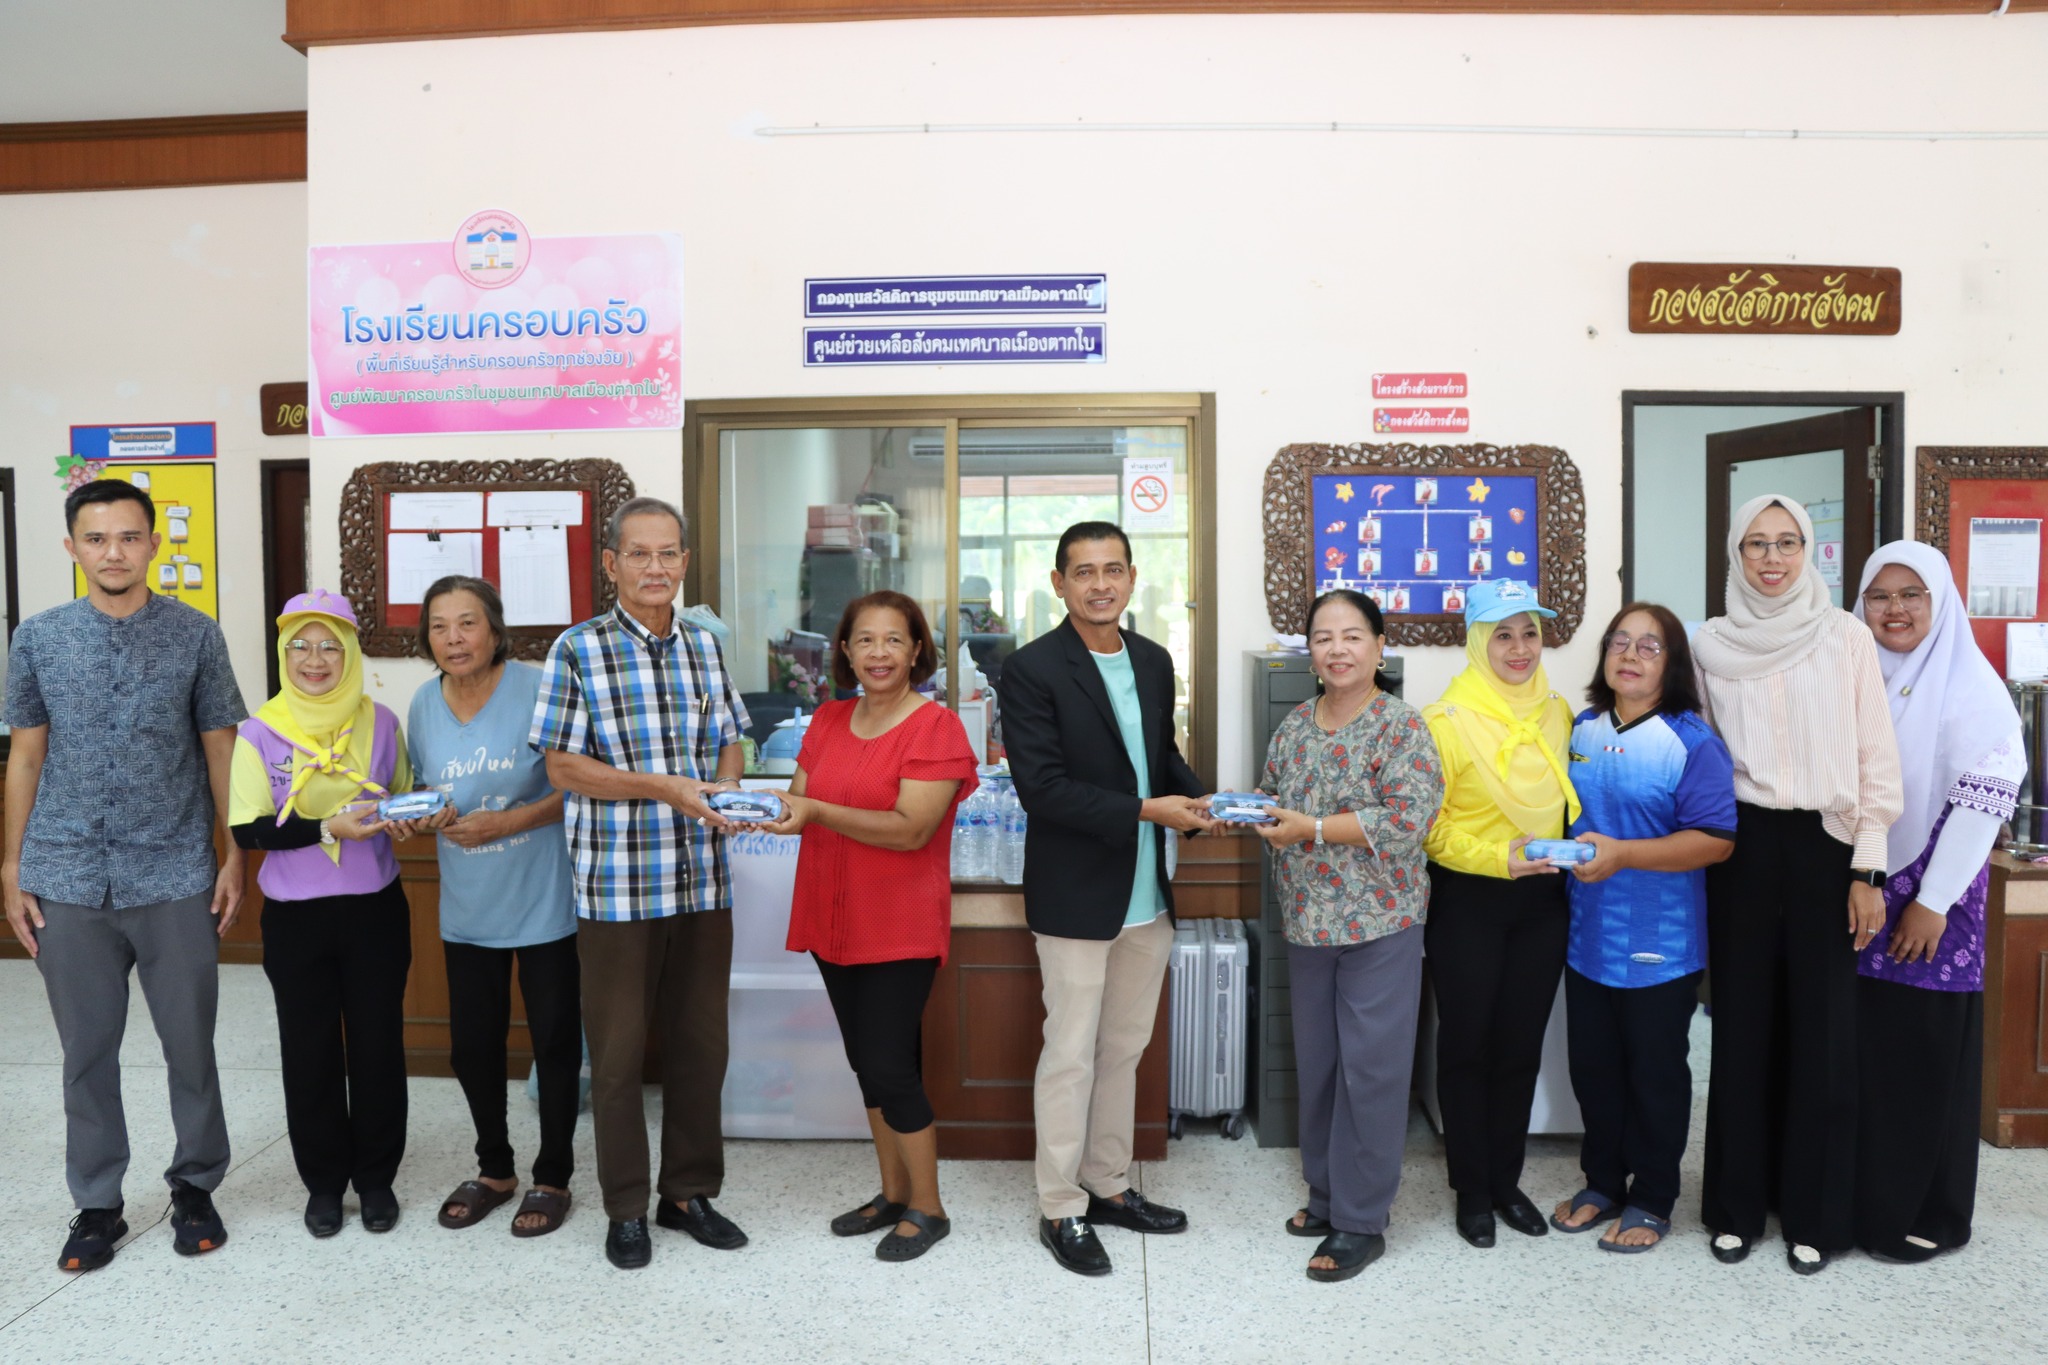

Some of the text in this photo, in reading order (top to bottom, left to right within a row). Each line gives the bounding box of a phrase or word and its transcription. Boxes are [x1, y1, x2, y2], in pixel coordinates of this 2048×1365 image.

[816, 283, 1093, 309] กองทุนสวัสดิการชุมชนเทศบาลเมืองตากใบ
[1649, 269, 1885, 329] กองสวัสดิการสังคม
[340, 297, 649, 345] โรงเรียนครอบครัว
[813, 326, 1096, 362] ศูนย์ช่วยเหลือสังคมเทศบาลเมืองตากใบ
[329, 377, 662, 410] ศูนย์พัฒนาครอบครัวในชุมชนเทศบาลเมืองตากใบ
[1373, 374, 1465, 395] โครงสร้างส่วนราชการ
[1390, 407, 1468, 426] กองสวัสดิการสังคม
[441, 746, 516, 779] เชียงใหม่
